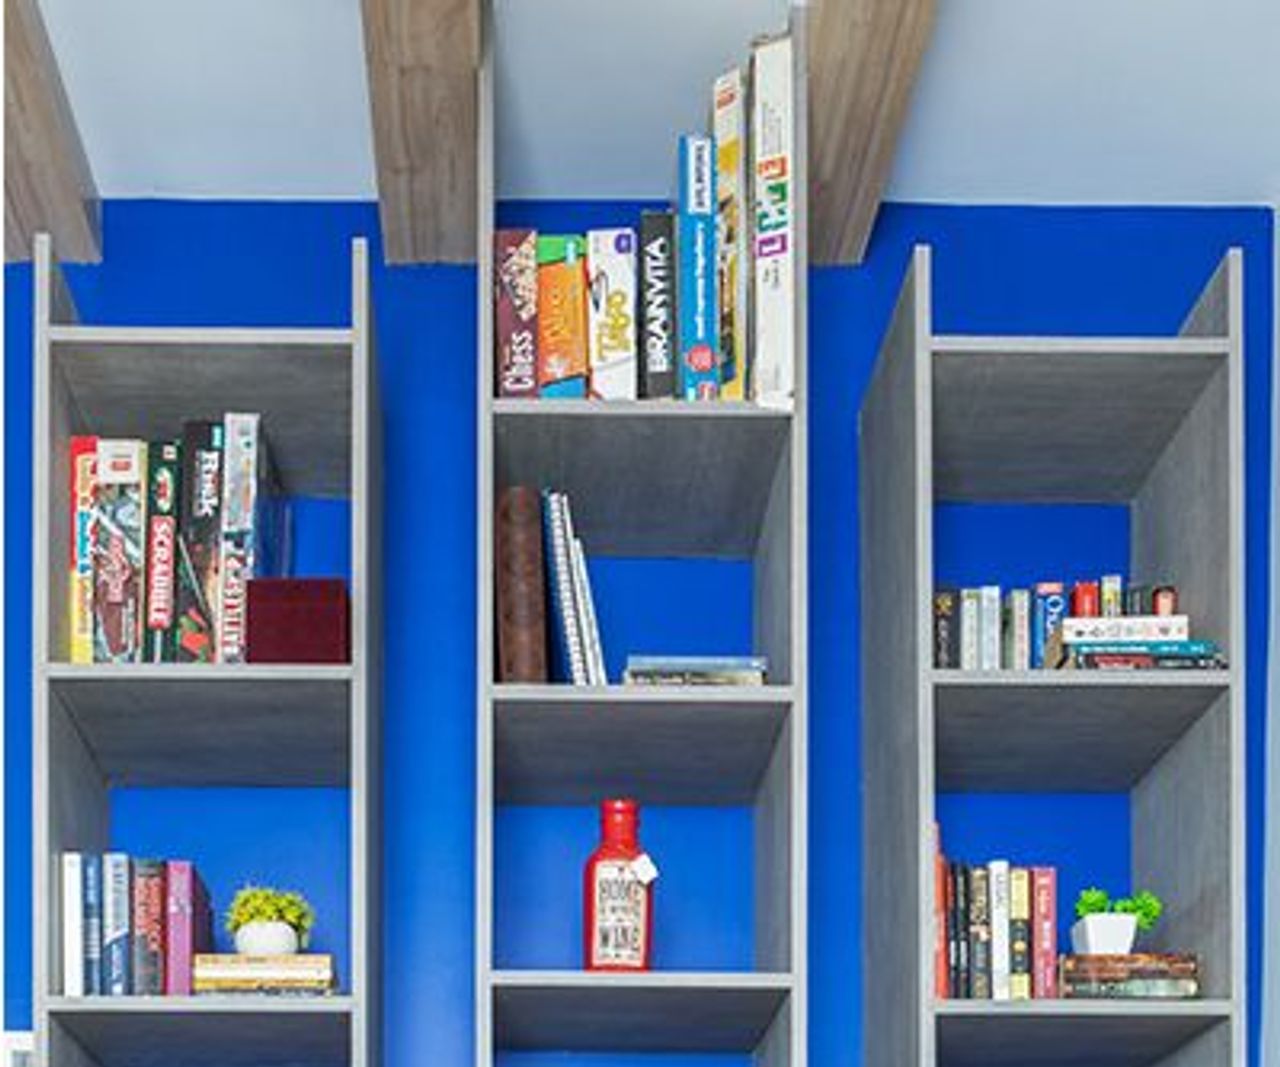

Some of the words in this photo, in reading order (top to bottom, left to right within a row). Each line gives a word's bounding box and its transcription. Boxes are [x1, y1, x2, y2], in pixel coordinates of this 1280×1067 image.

[757, 157, 788, 258] LIFE
[646, 237, 670, 373] BRAINVITA
[503, 333, 534, 390] Chess
[194, 450, 219, 517] Risk
[151, 521, 175, 626] SCRABBLE
